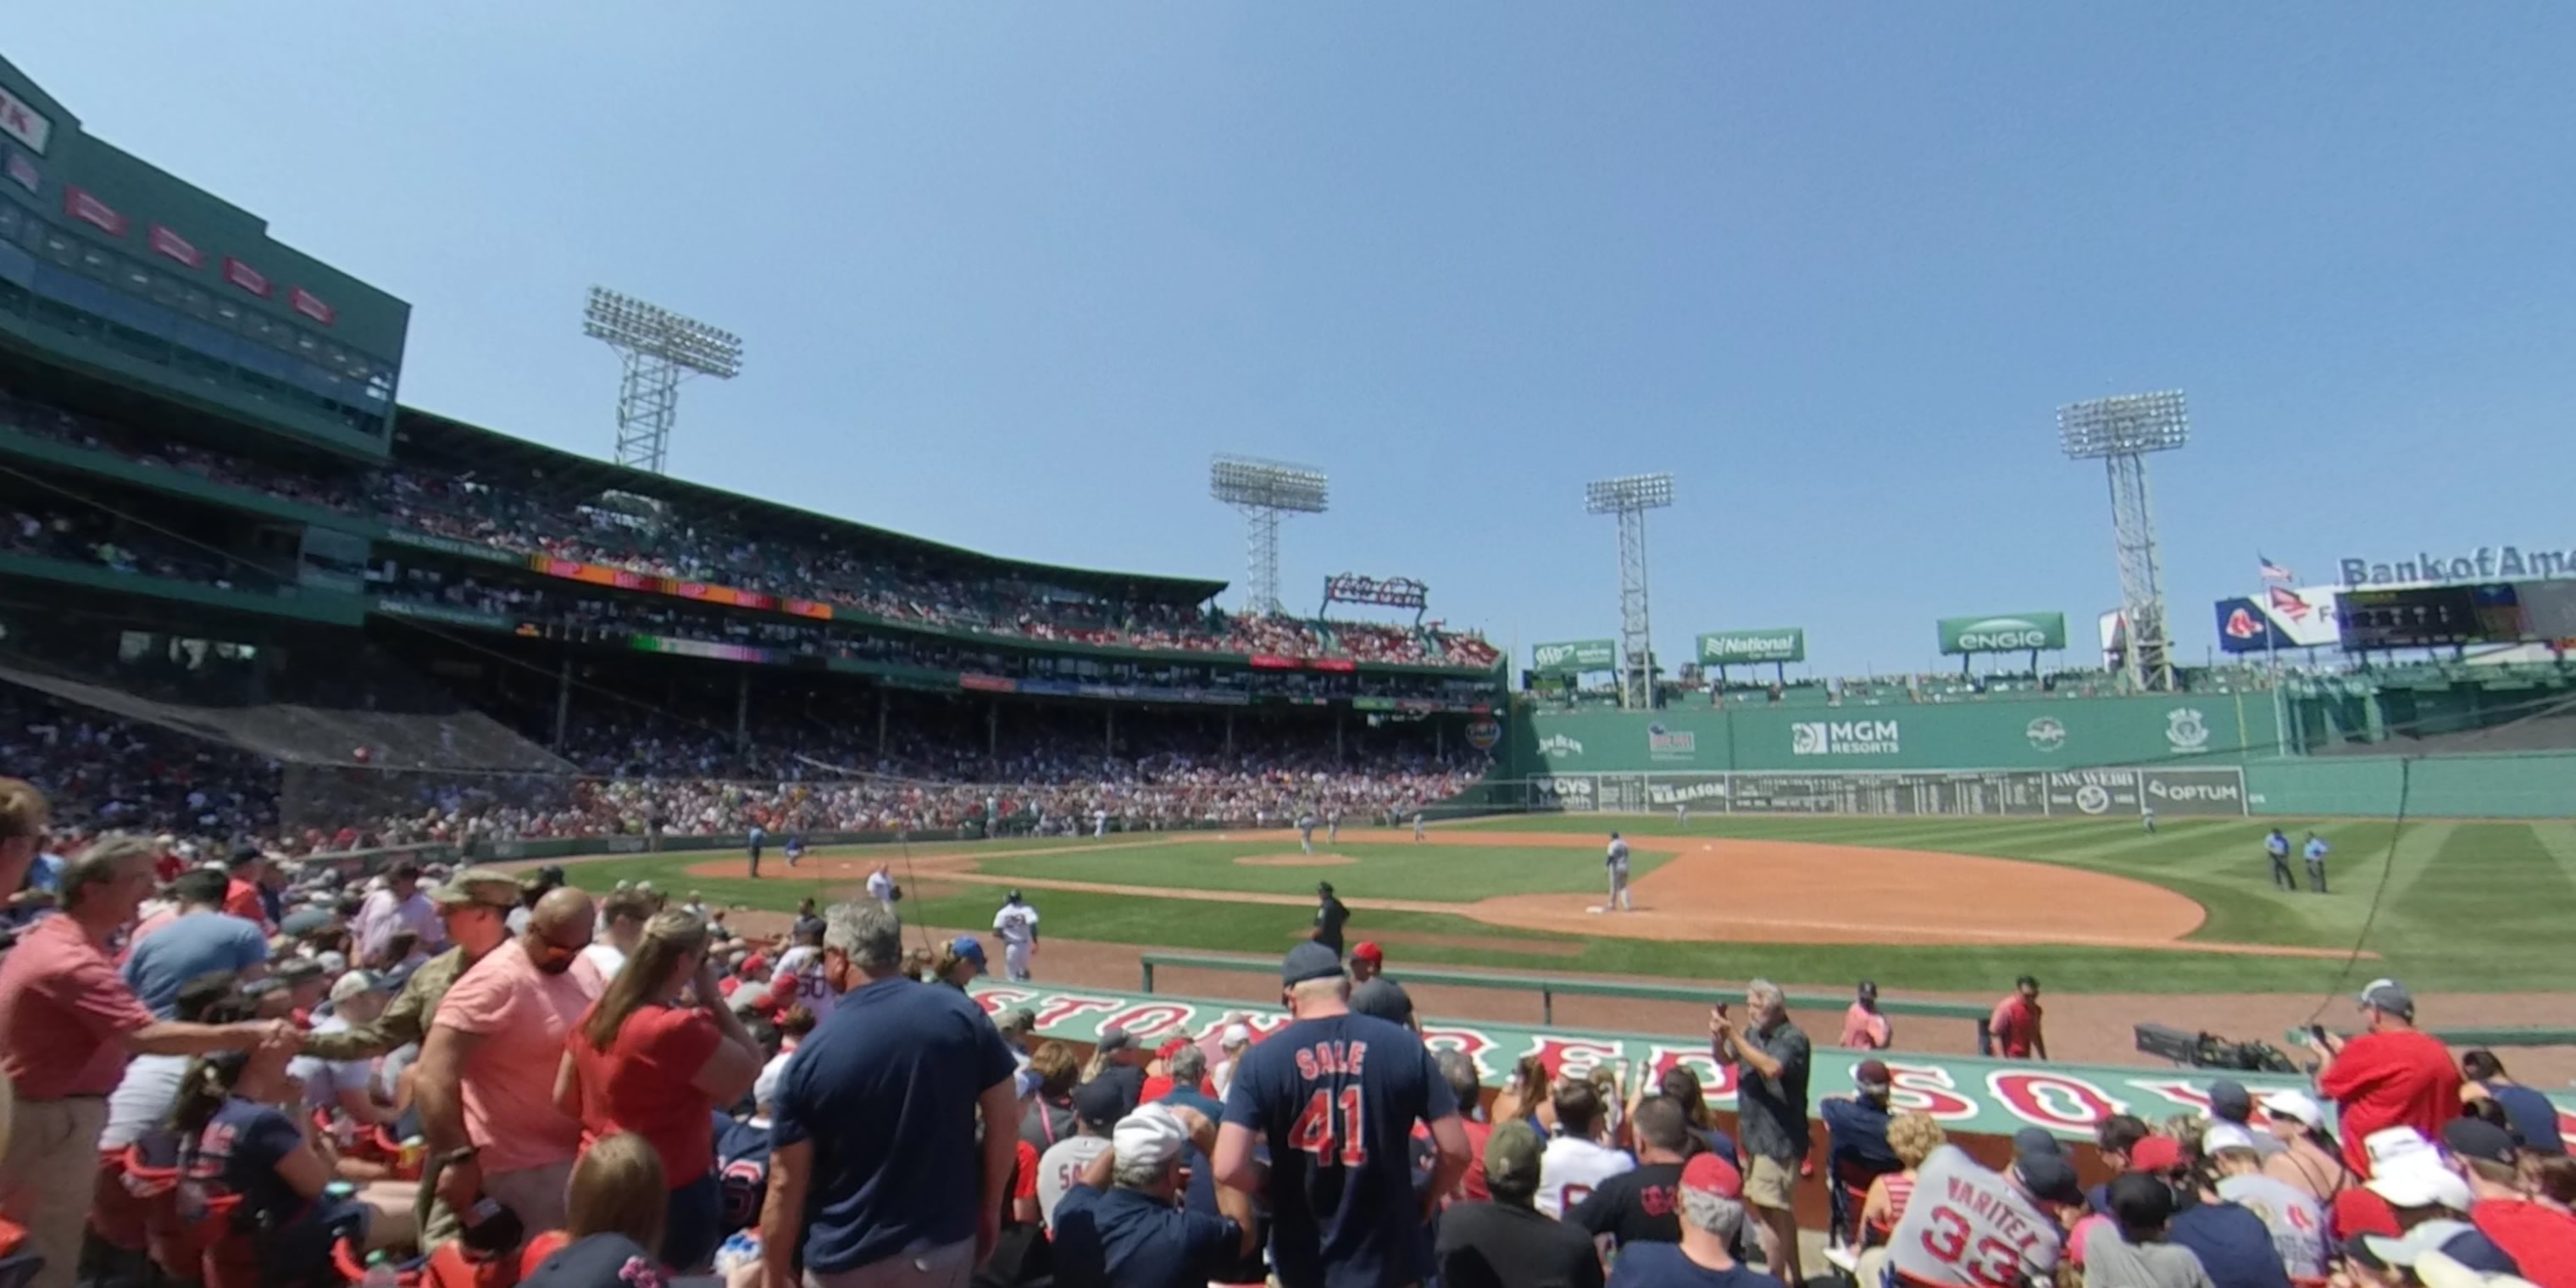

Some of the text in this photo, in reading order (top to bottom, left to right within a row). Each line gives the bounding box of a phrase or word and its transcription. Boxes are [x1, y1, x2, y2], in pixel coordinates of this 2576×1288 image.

[2339, 552, 2442, 586] Bank
[2446, 547, 2496, 578] of
[1724, 635, 1795, 653] National
[1830, 720, 1898, 741] MGM
[1830, 741, 1900, 754] RESORTS
[1553, 777, 1591, 795] CVS
[2169, 785, 2238, 801] OPTUM
[1296, 1041, 1367, 1080] SALE
[1288, 1084, 1368, 1167] 41
[1920, 1204, 2020, 1286] 33
